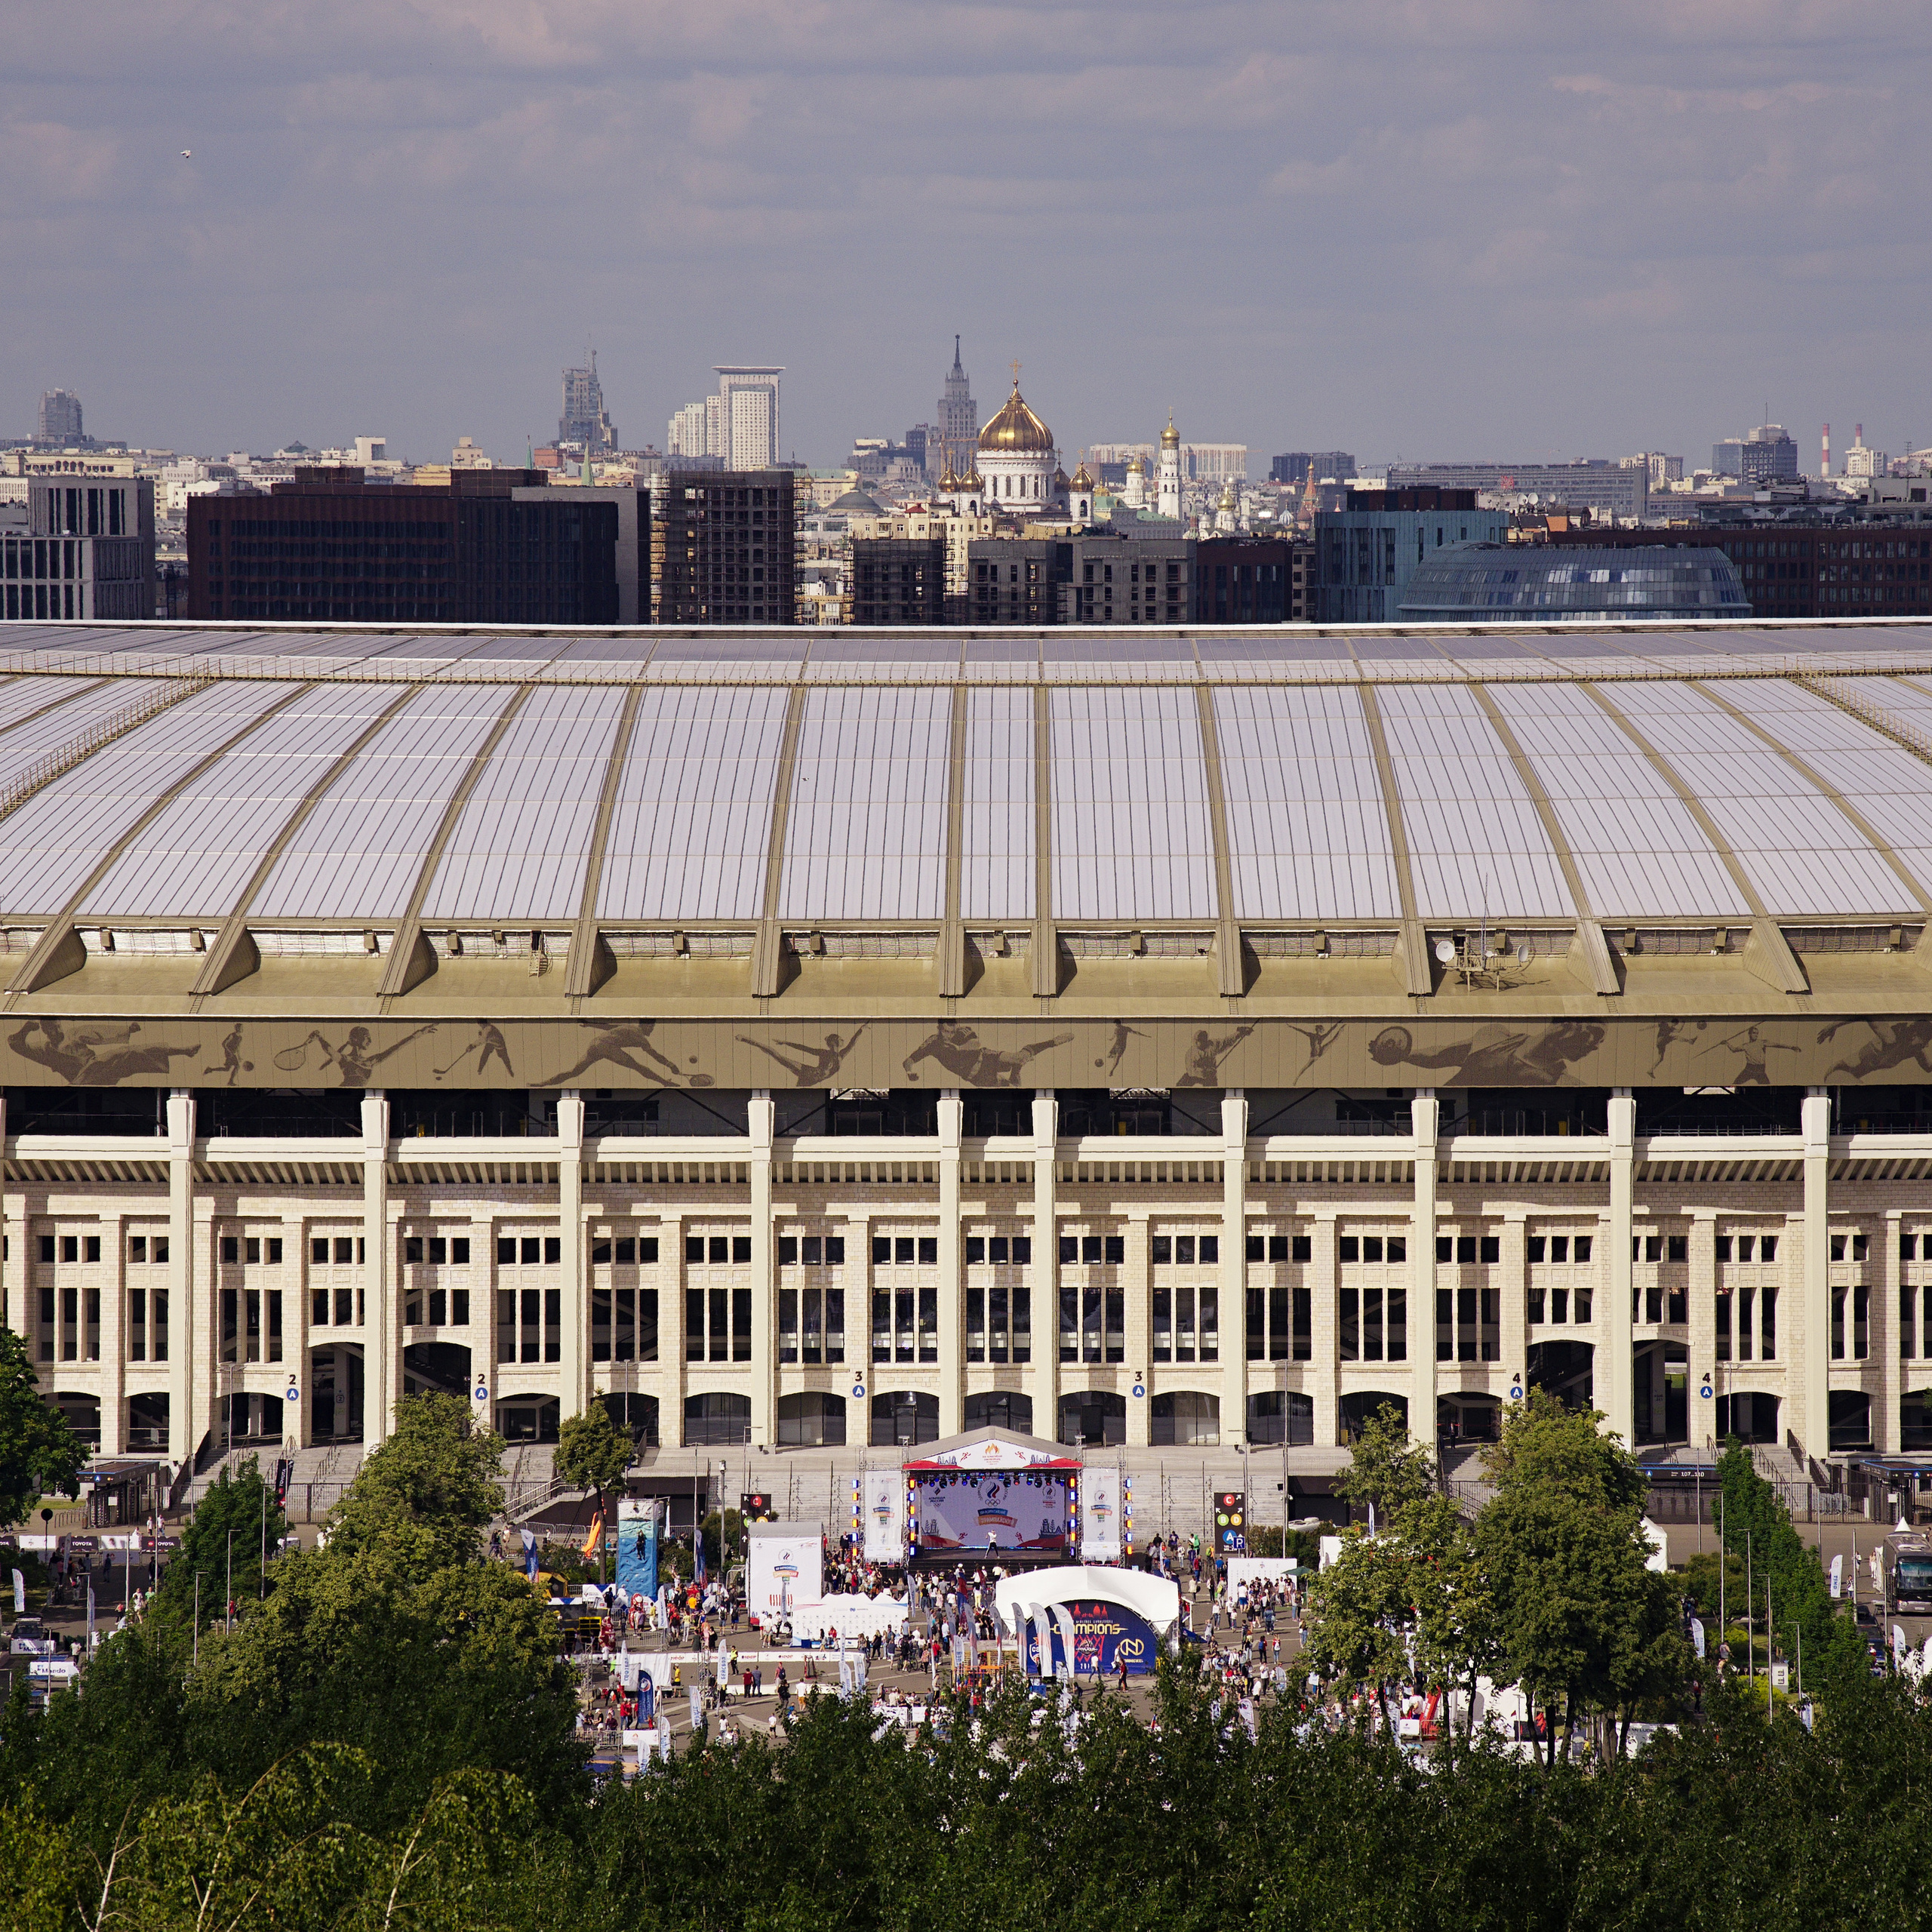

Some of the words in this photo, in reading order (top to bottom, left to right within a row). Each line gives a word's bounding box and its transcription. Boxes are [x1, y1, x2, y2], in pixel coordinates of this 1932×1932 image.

[288, 1374, 297, 1385] 2
[477, 1374, 485, 1384] 2
[855, 1371, 863, 1382] 3
[1134, 1371, 1143, 1382] 3
[1512, 1373, 1521, 1383] 4
[1703, 1373, 1711, 1383] 4
[1051, 1623, 1123, 1635] CMPIONS
